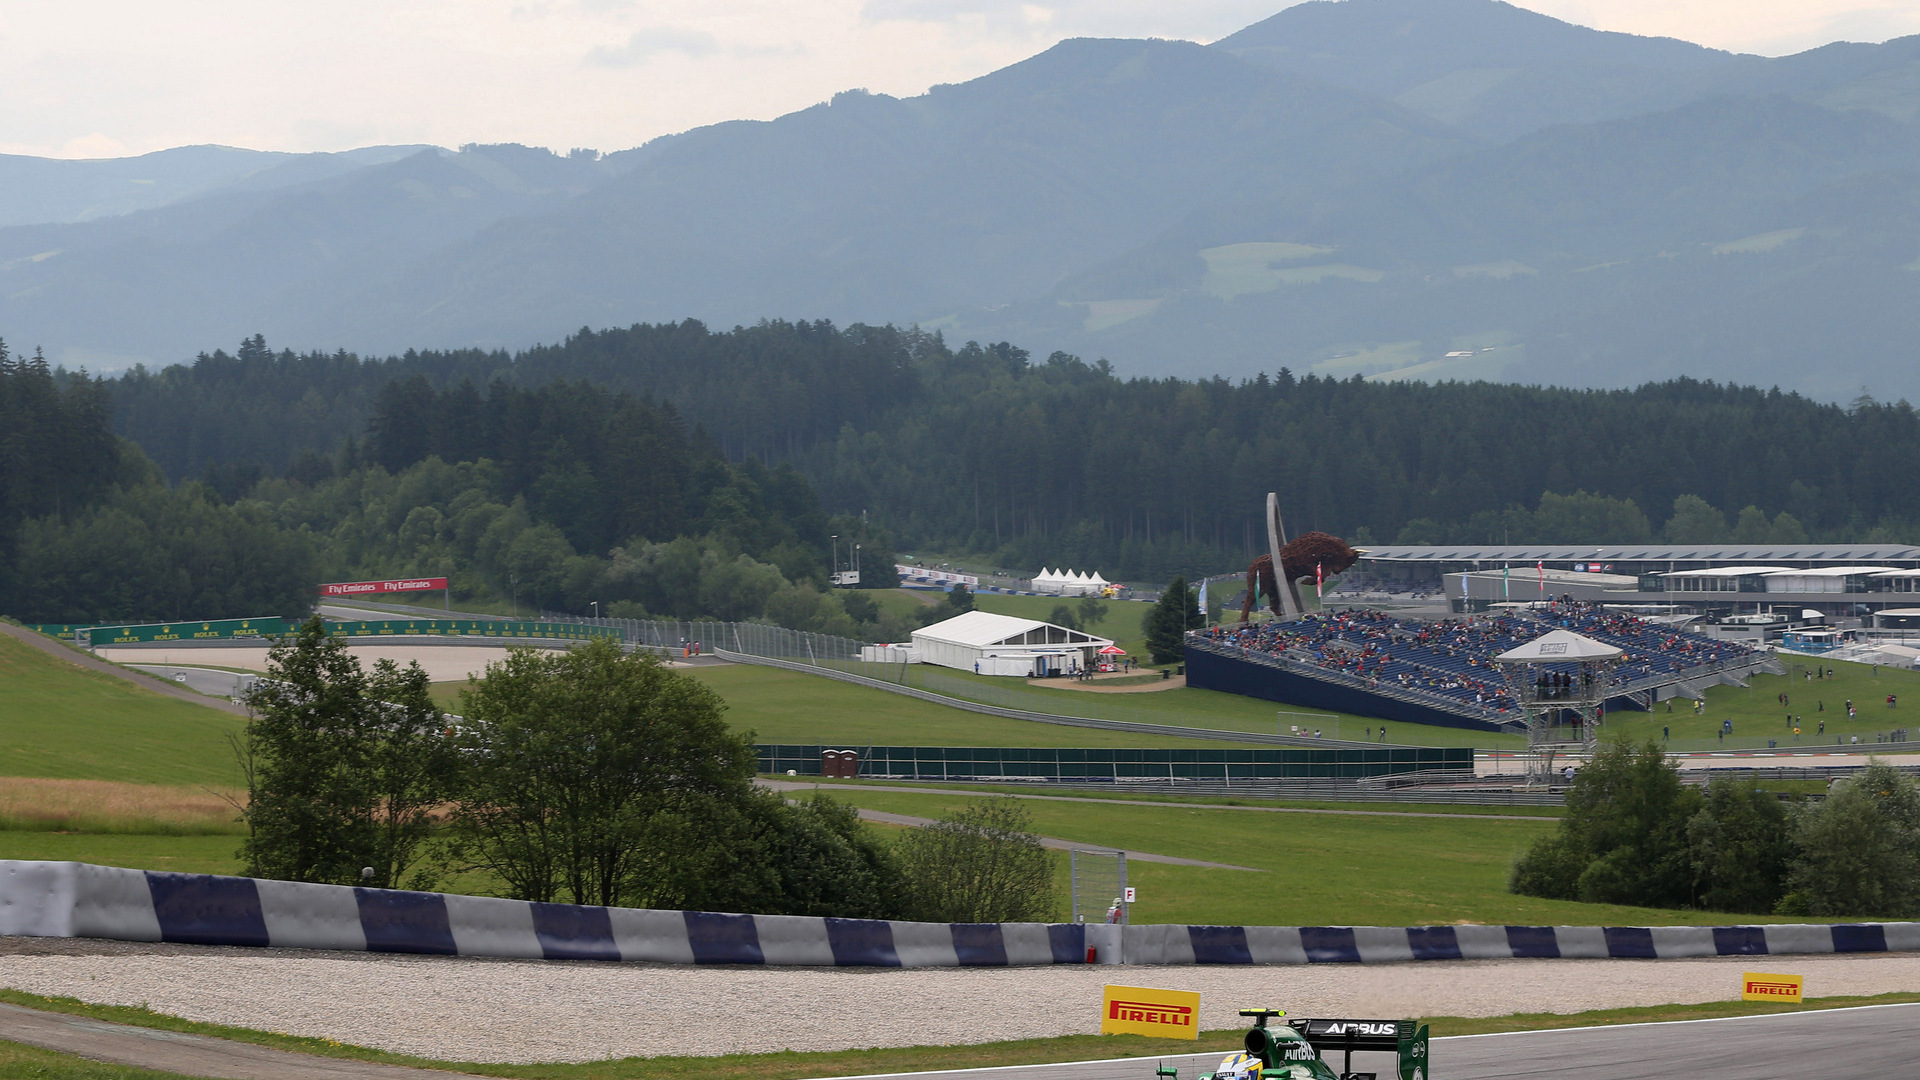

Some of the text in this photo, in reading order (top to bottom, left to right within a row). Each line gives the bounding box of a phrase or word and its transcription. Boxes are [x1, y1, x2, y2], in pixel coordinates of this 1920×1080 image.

[329, 584, 375, 594] Fly Emirates
[384, 580, 431, 591] Fly Emirates
[233, 628, 259, 636] ROLEX
[1126, 890, 1133, 899] F
[1746, 981, 1798, 996] PIRELLI
[1109, 1000, 1192, 1026] PIRELLI
